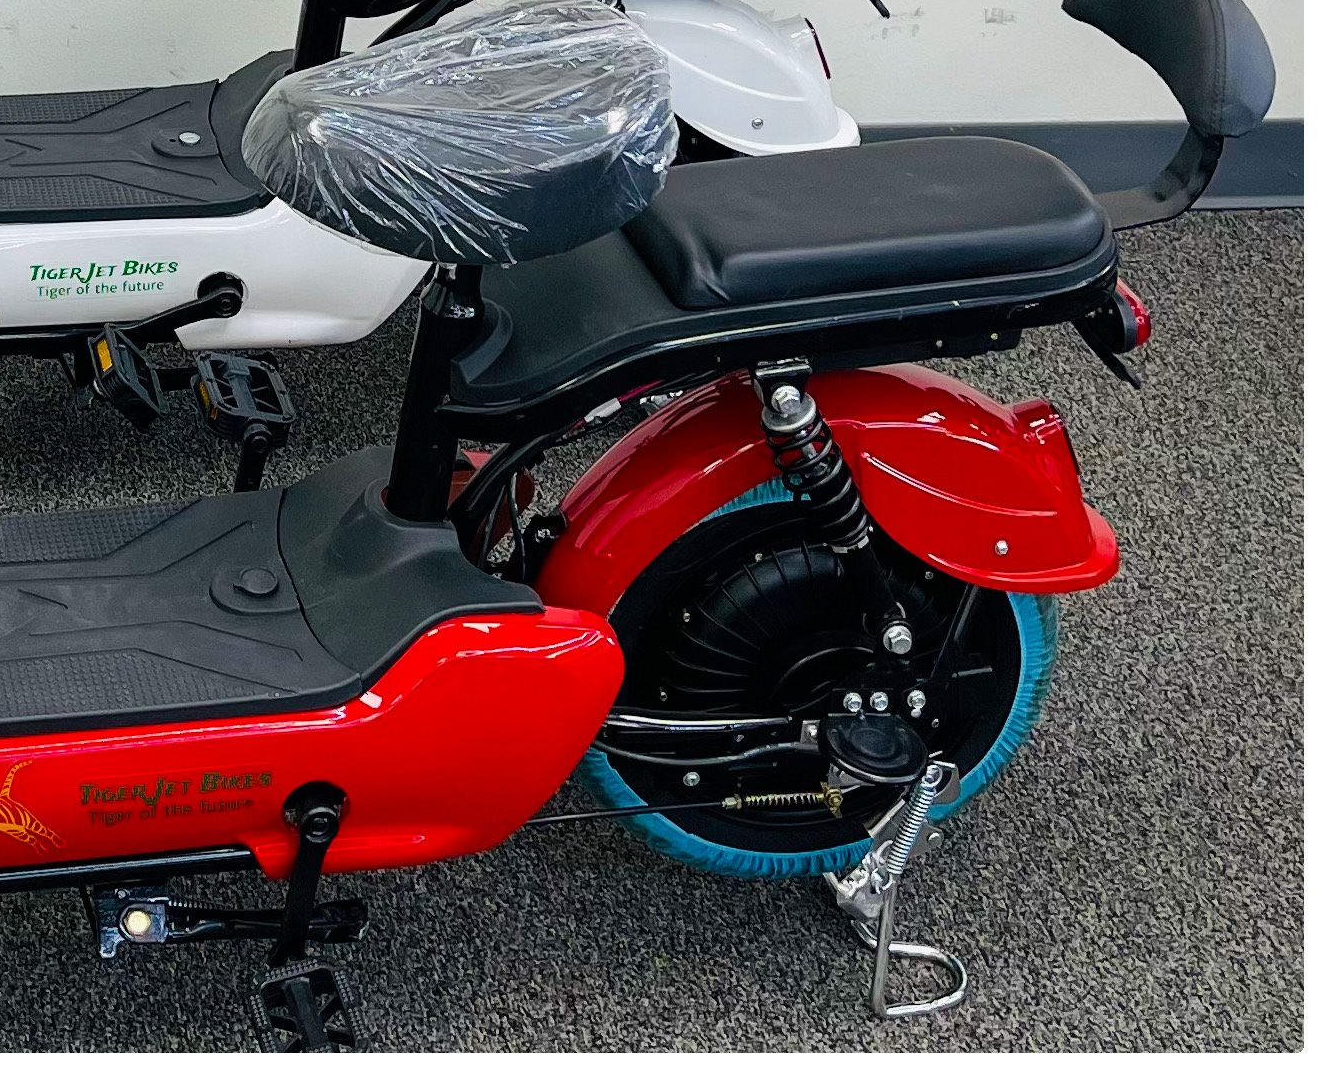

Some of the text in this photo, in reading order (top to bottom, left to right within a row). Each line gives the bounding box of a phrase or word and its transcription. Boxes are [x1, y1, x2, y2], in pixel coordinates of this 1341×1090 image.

[37, 280, 164, 300] Tiger of the future
[88, 799, 254, 826] Tiger of the future
